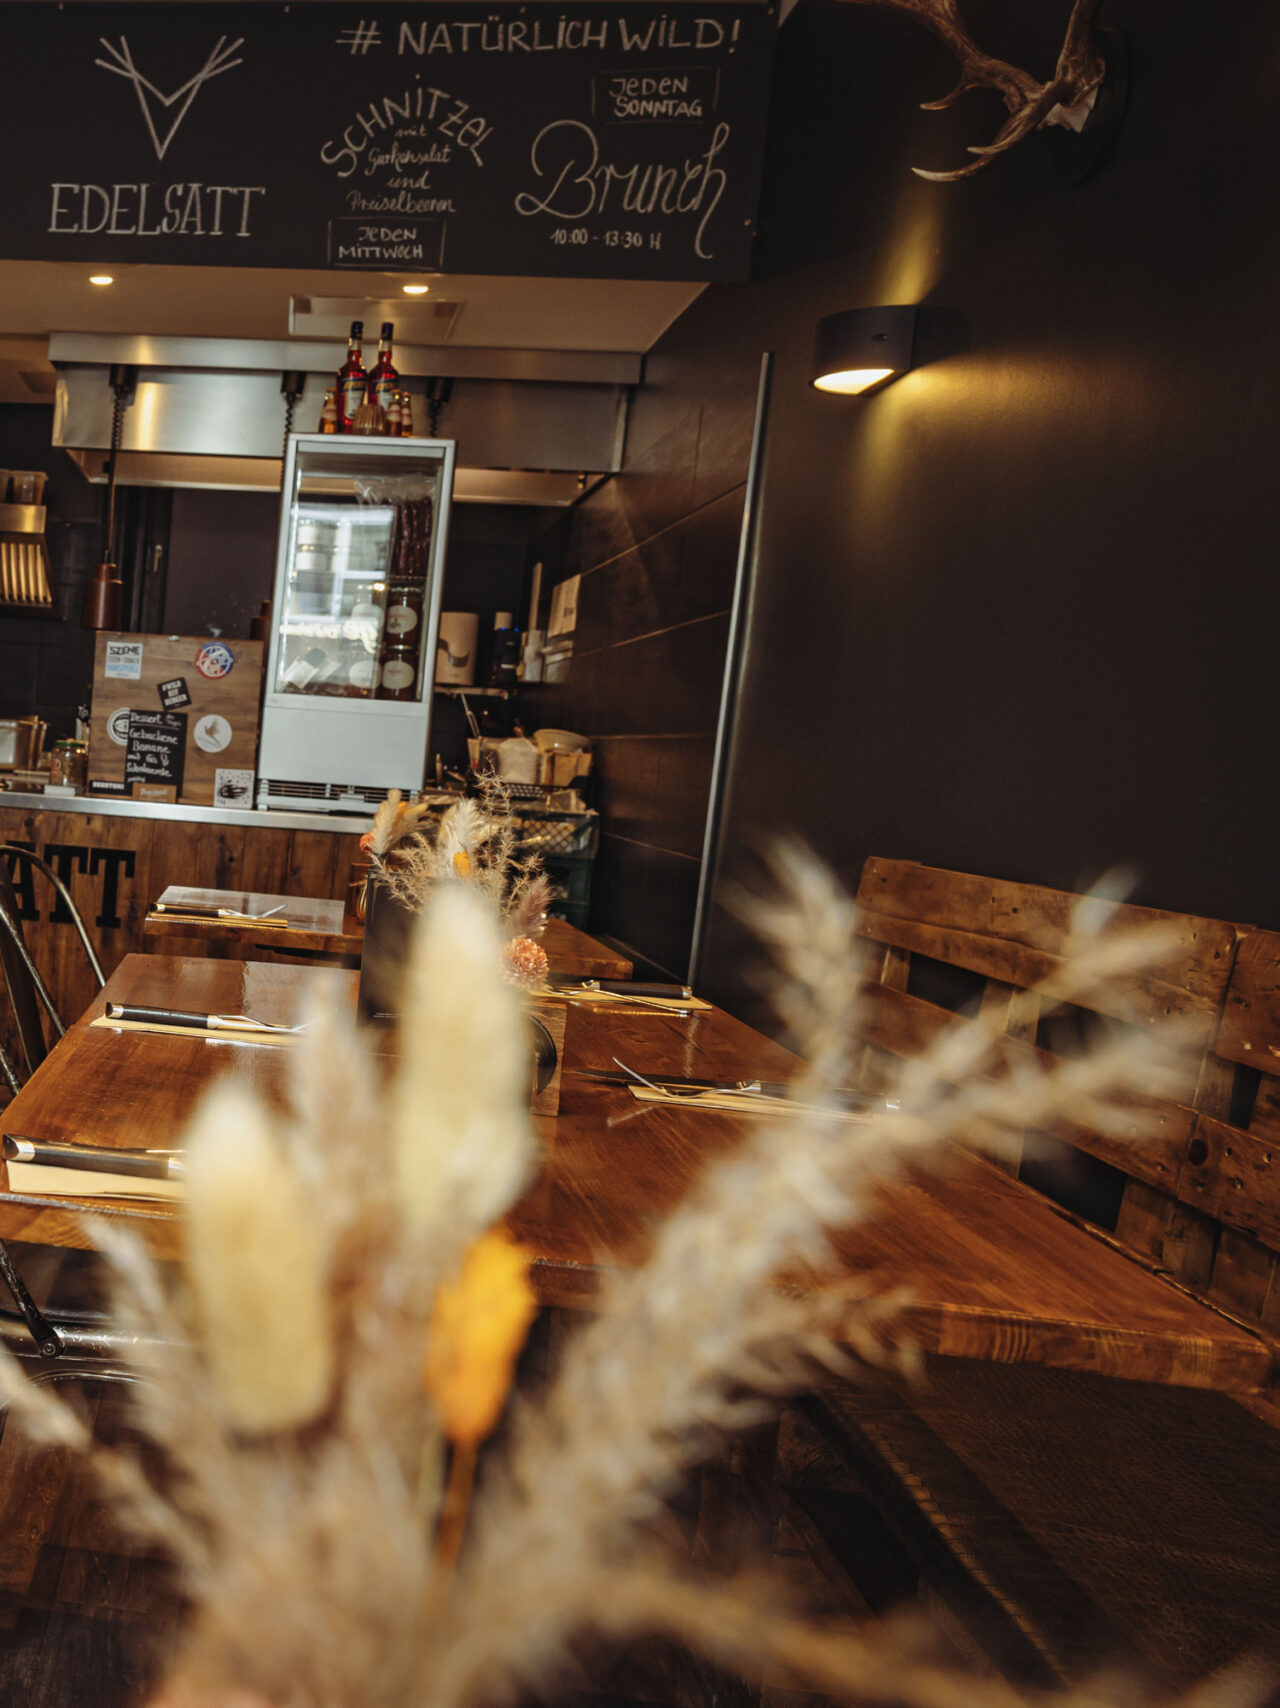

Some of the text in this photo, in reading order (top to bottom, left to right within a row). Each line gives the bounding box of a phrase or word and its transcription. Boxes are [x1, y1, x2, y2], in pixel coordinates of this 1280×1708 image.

[613, 96, 703, 117] SONNTAG
[394, 123, 428, 137] mit
[386, 170, 432, 189] und
[514, 119, 730, 259] Brunch
[47, 183, 266, 237] EDELSATT
[549, 228, 589, 245] 10:00
[603, 229, 644, 249] 13:30
[109, 645, 141, 656] SZENE
[132, 740, 171, 754] Banane
